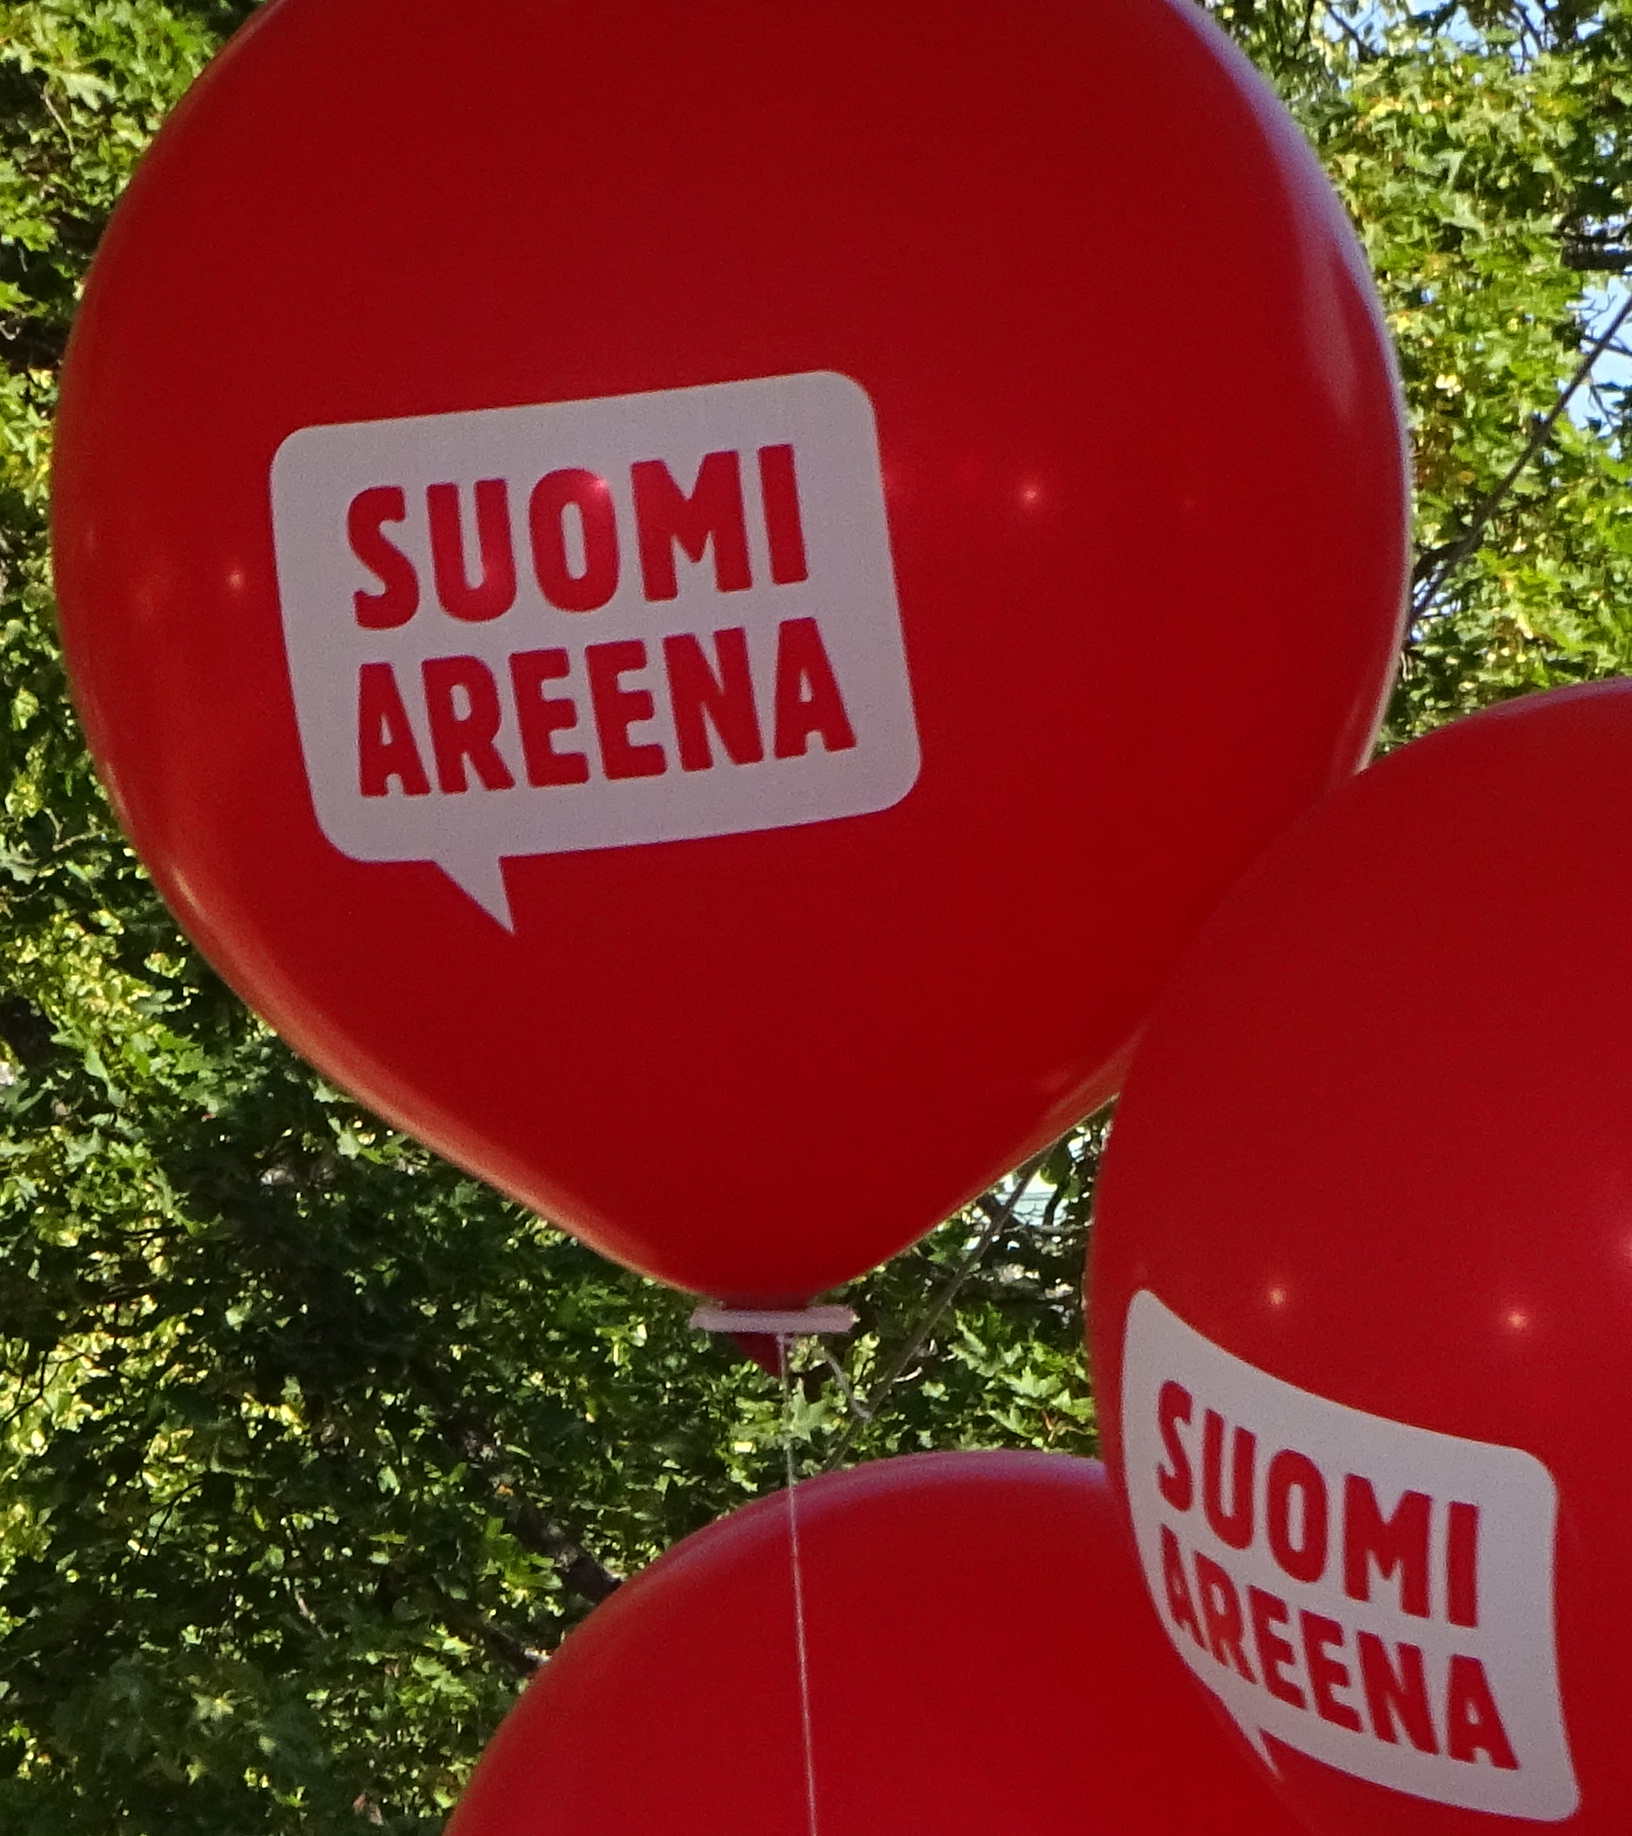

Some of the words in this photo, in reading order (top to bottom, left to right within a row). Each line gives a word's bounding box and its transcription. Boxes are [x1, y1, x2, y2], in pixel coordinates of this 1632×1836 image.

[346, 443, 808, 631] SUOMI
[356, 616, 857, 798] AREENA
[1157, 1379, 1479, 1629] SUOMI
[1160, 1523, 1519, 1770] AREENA
